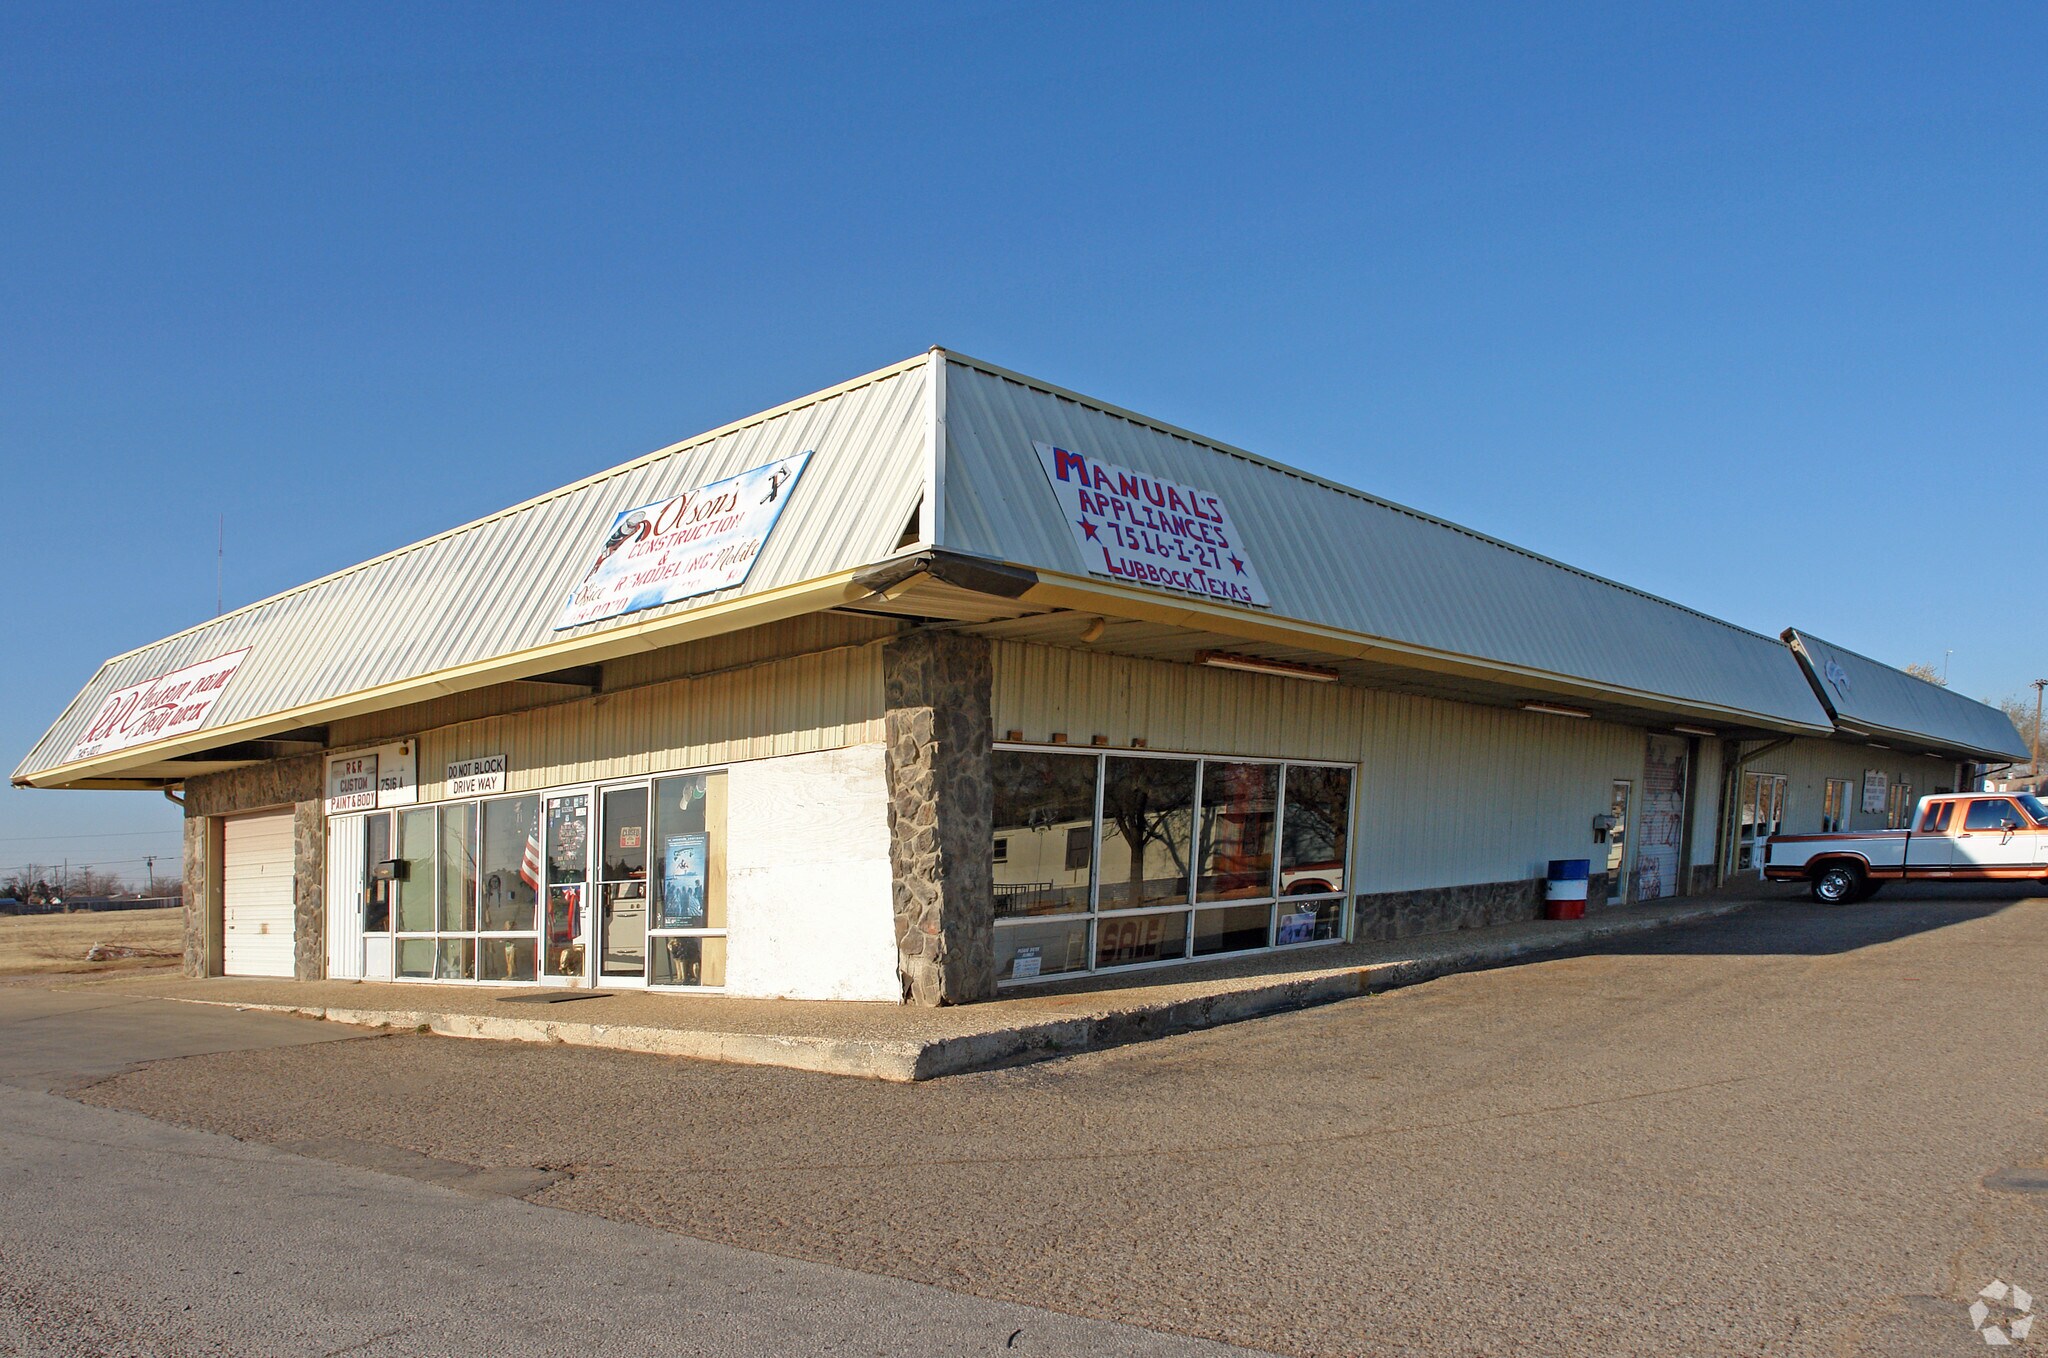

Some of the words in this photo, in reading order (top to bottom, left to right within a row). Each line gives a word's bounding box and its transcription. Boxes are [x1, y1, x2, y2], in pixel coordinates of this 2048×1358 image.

[1053, 446, 1223, 524] MANUAL'S
[653, 482, 740, 536] Olson's
[1078, 488, 1230, 548] APPLIANCE'S
[628, 511, 746, 559] CONSTRUCTION
[658, 550, 670, 566] &
[710, 539, 760, 571] Mobile
[1193, 568, 1252, 602] TEXAS
[340, 777, 368, 792] CUSTOM
[448, 765, 458, 779] DO
[458, 762, 472, 777] NOT
[474, 758, 504, 775] BLOCK
[453, 778, 476, 794] DRIVE
[478, 776, 498, 791] WAY
[331, 795, 351, 811] PAINT
[357, 792, 375, 807] BODY
[1100, 917, 1160, 962] SALE
